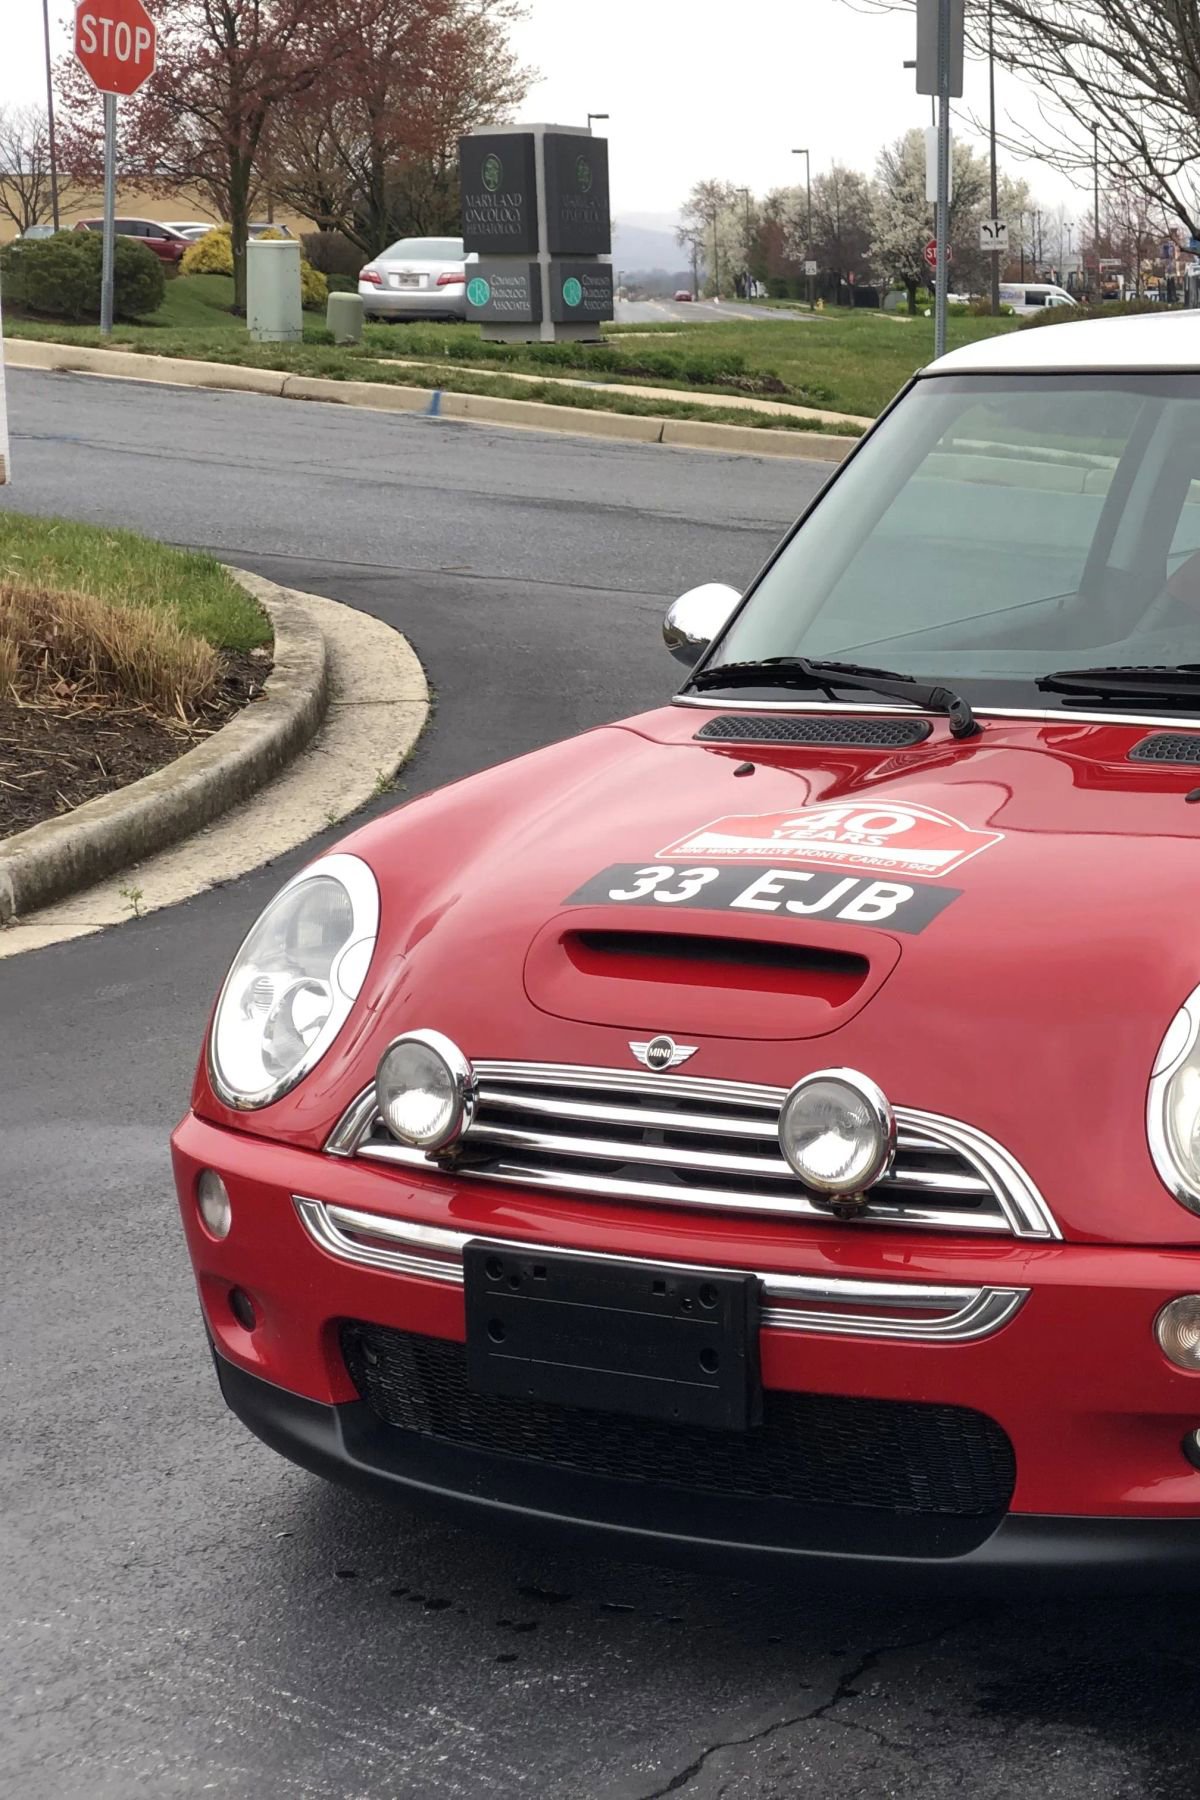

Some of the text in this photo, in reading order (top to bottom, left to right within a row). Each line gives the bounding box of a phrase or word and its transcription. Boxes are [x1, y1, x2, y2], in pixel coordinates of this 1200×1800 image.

[80, 14, 151, 64] STOP
[465, 193, 522, 207] MARYLAND
[466, 208, 521, 222] ONCOLOGY
[781, 809, 916, 836] 40
[771, 829, 889, 846] YEARS
[708, 847, 742, 855] WINS
[743, 847, 793, 856] RALLYE
[794, 848, 847, 860] MONTE
[848, 854, 897, 867] CARLO
[900, 861, 937, 873] 1964
[608, 866, 915, 922] 33 EJB
[648, 1047, 671, 1058] MINI
